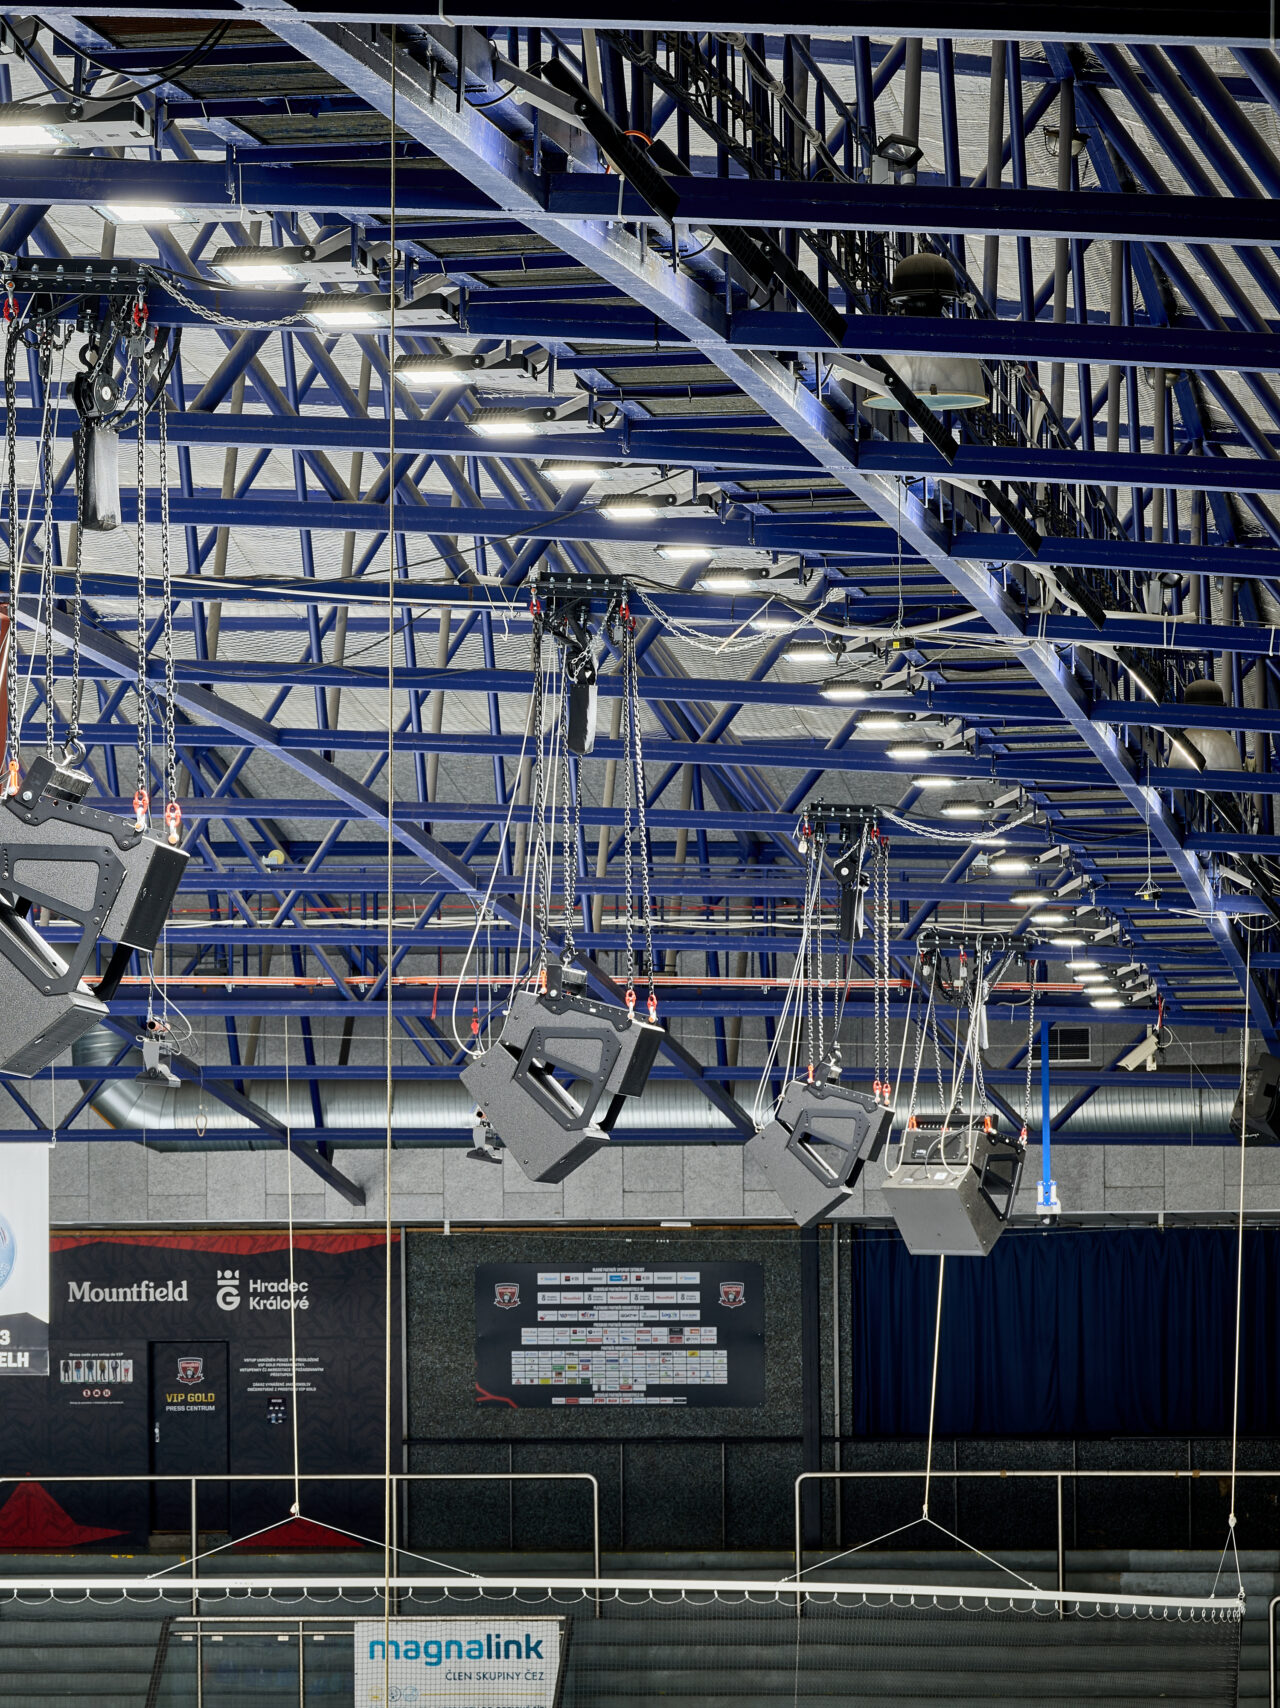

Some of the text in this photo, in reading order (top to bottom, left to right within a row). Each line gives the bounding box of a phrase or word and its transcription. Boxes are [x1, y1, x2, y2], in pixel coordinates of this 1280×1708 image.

[67, 1280, 189, 1303] Mountfield
[249, 1278, 309, 1293] Hradec
[249, 1295, 310, 1310] Králové
[165, 1393, 216, 1403] VIP GOLD
[369, 1633, 544, 1667] magnalink
[445, 1669, 545, 1681] ČLEN SKUPINY ČEZ
